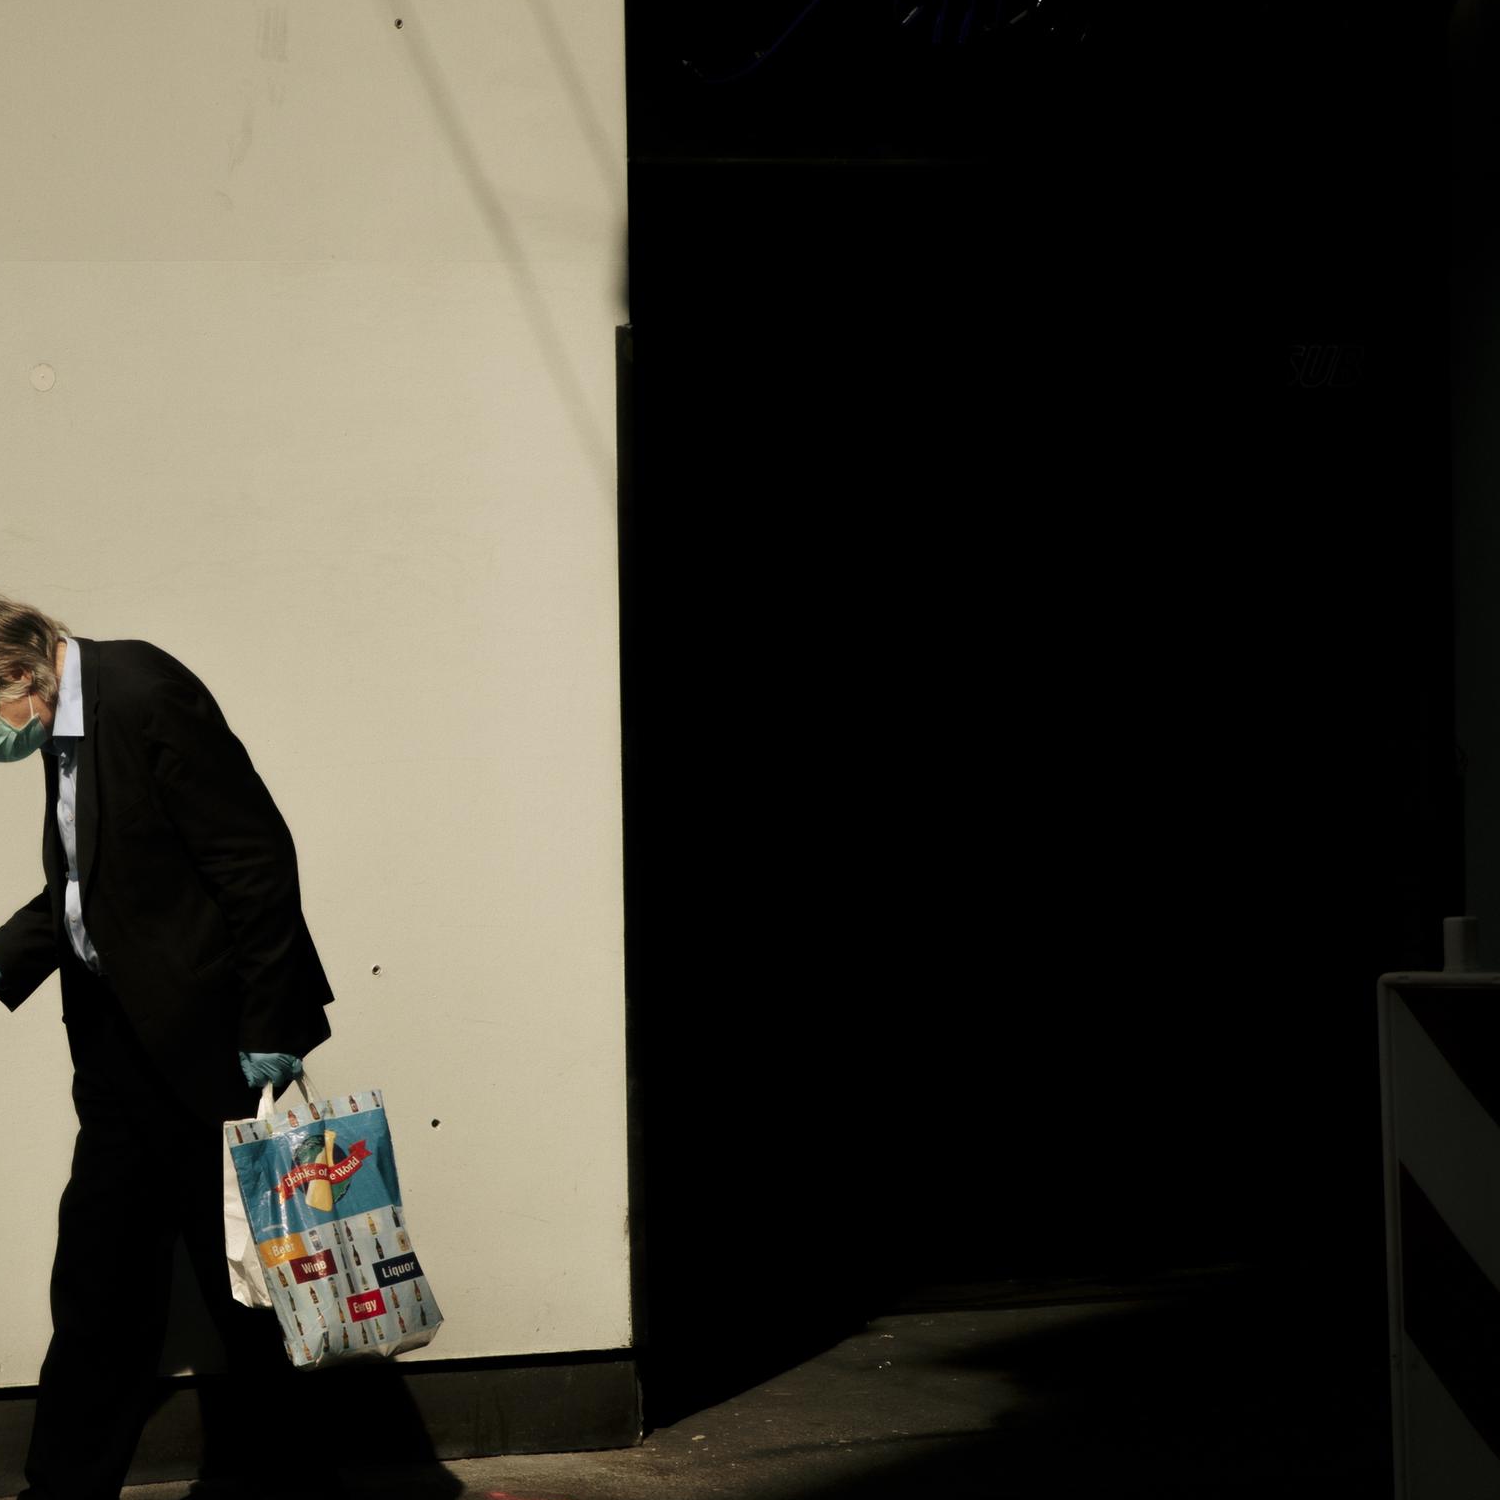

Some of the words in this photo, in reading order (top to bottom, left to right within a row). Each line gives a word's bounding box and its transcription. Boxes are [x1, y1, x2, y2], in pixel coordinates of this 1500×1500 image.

[285, 1167, 316, 1187] Drinks
[335, 1156, 360, 1177] World
[271, 1242, 295, 1257] Beer
[301, 1259, 327, 1274] Wine
[381, 1259, 415, 1279] Liquor
